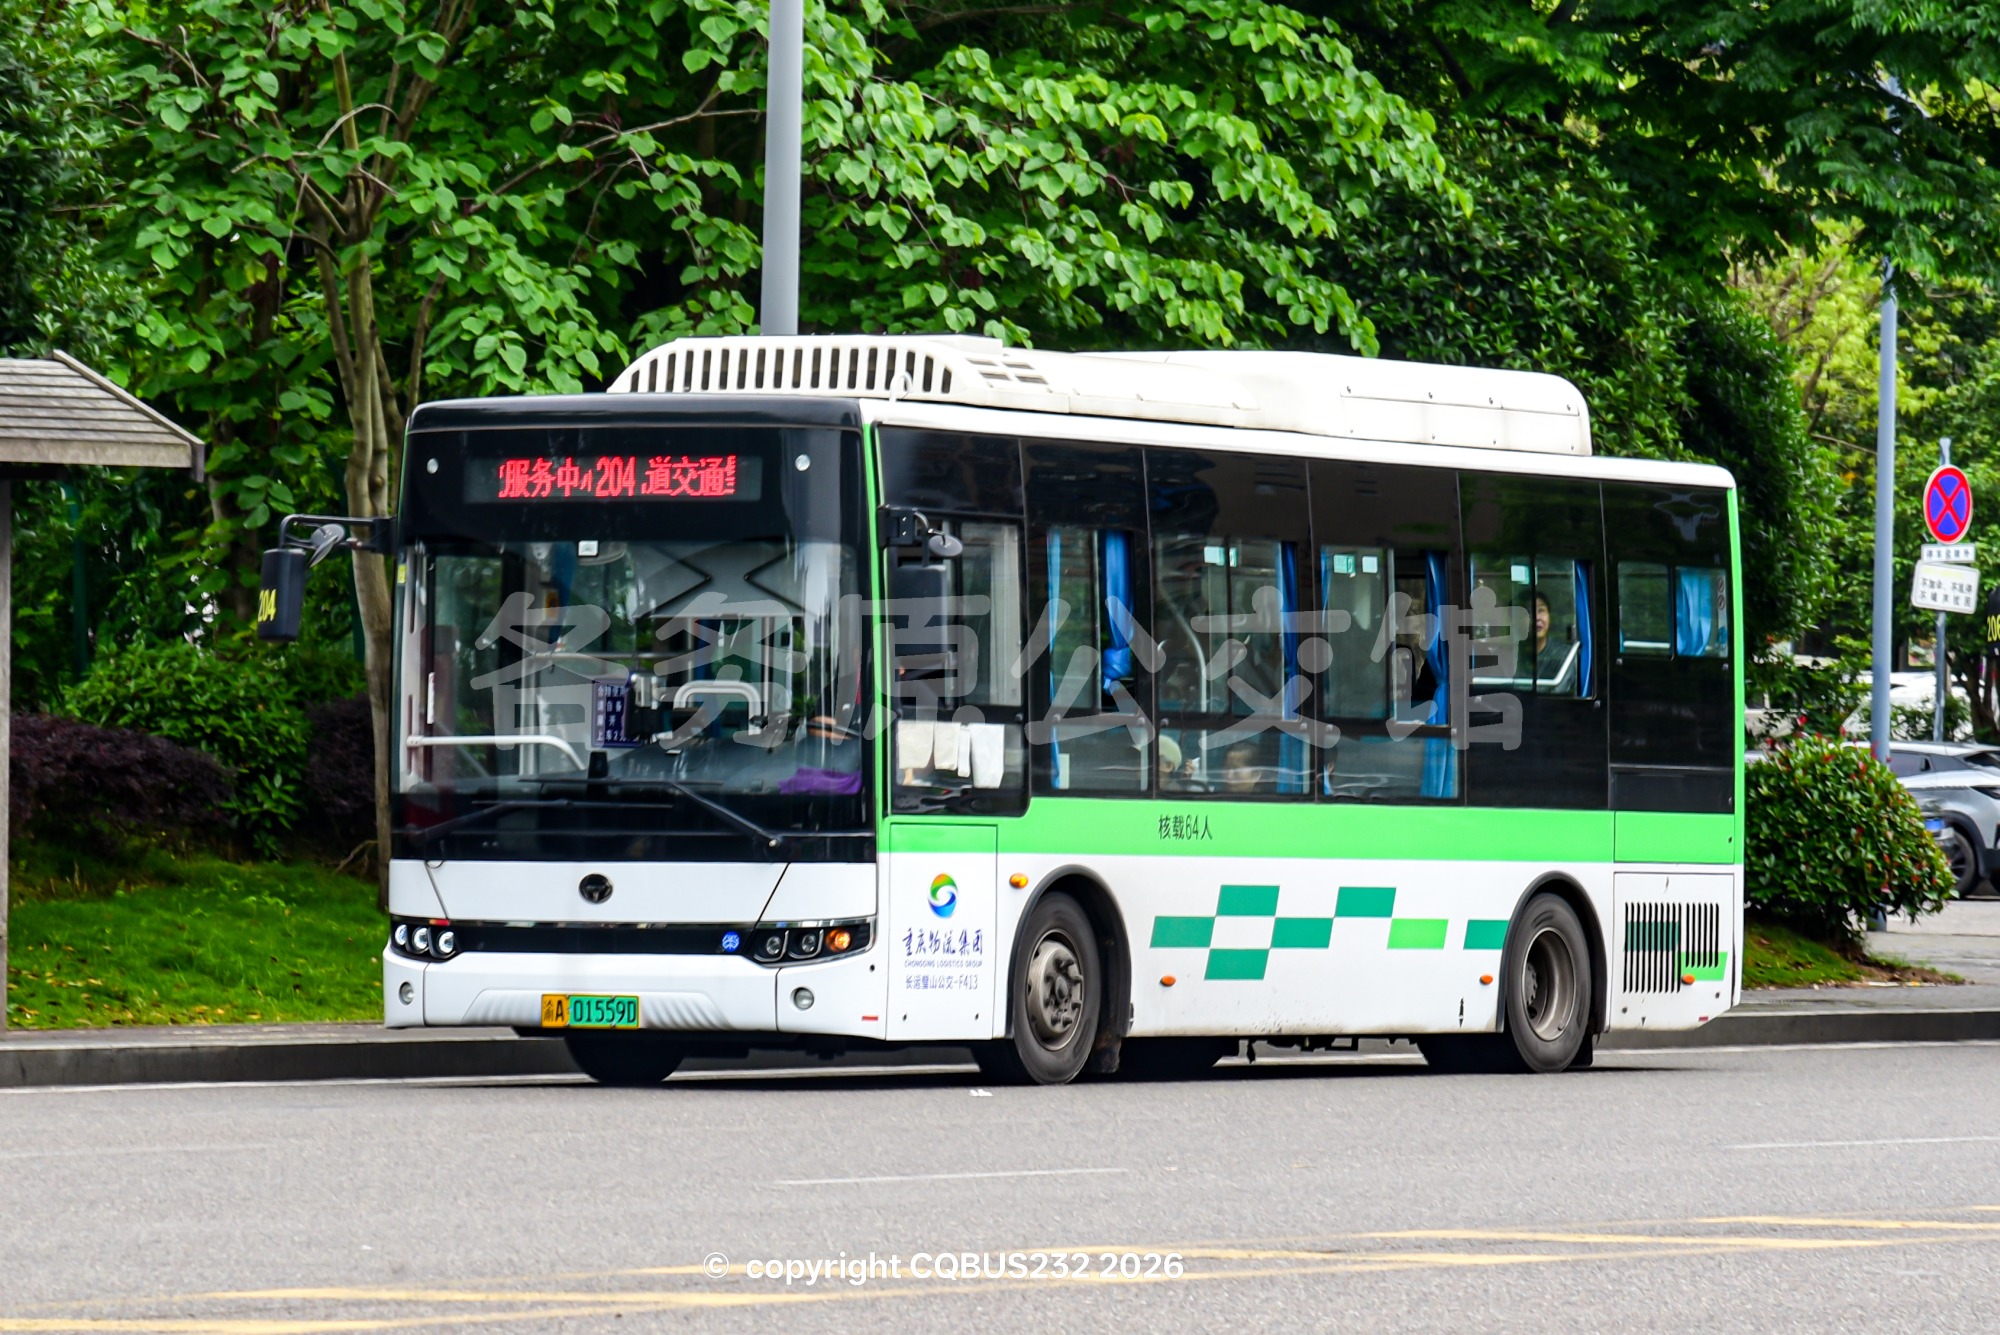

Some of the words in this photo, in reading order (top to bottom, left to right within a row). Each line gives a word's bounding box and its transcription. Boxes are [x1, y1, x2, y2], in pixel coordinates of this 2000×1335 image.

[595, 457, 637, 497] 204
[258, 589, 276, 622] 204
[1158, 814, 1213, 840] 核载64人
[902, 927, 983, 957] 重庆物流集团
[904, 959, 935, 968] CHONGQING
[936, 959, 964, 968] LOGISTICS
[965, 959, 983, 968] GROUP
